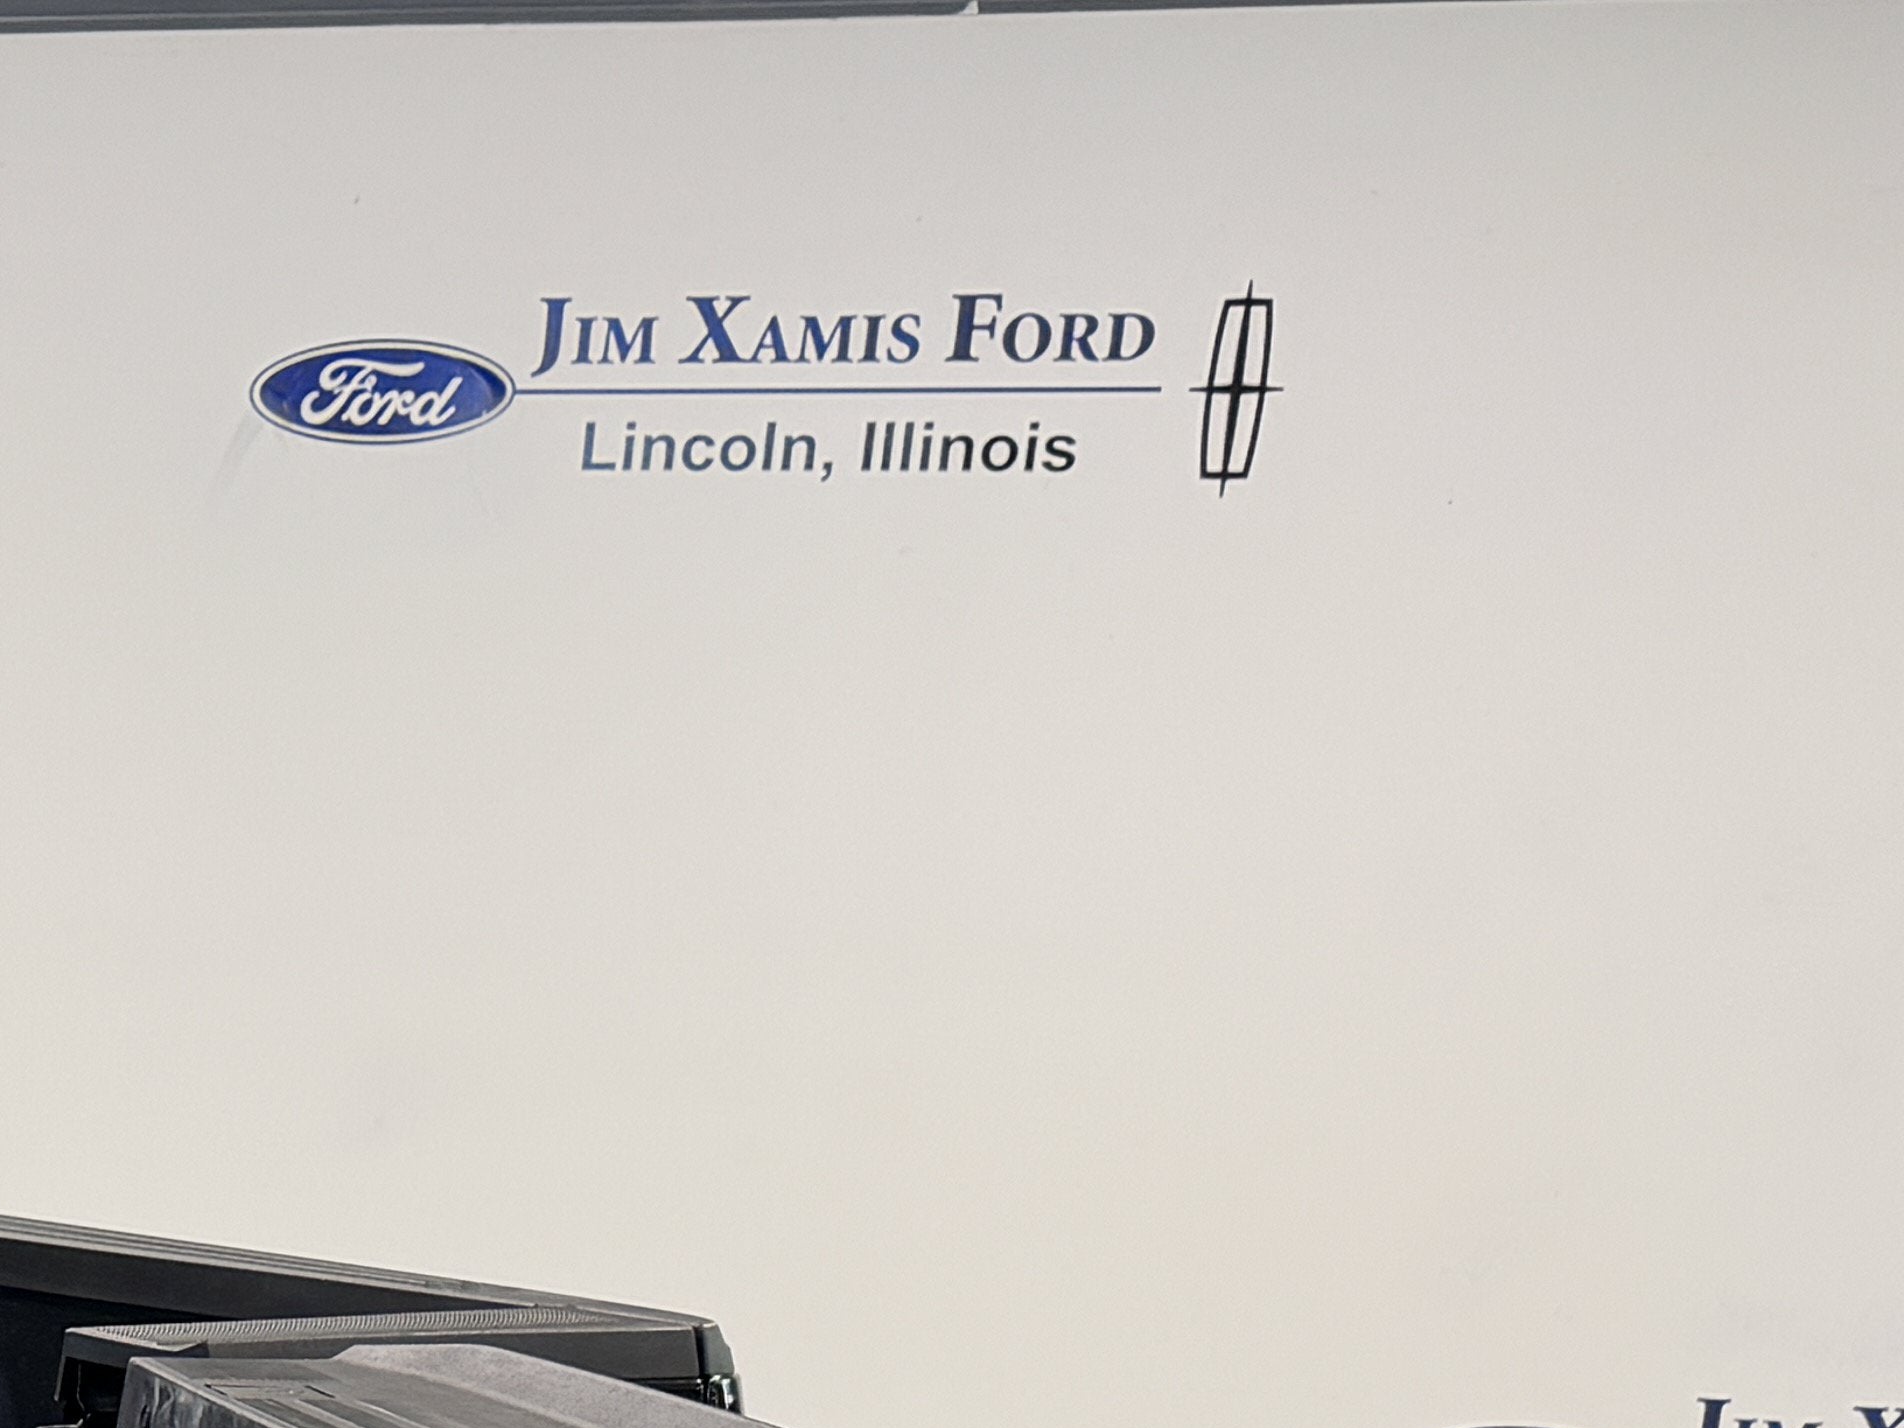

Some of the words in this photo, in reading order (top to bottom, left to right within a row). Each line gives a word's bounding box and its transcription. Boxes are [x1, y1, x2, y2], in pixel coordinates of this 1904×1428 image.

[530, 296, 660, 378] JIM
[678, 294, 923, 366] XAMIS
[943, 292, 1159, 364] FORD
[299, 358, 462, 428] Ford
[581, 420, 837, 482] Lincoln,
[860, 421, 1079, 475] Illinois
